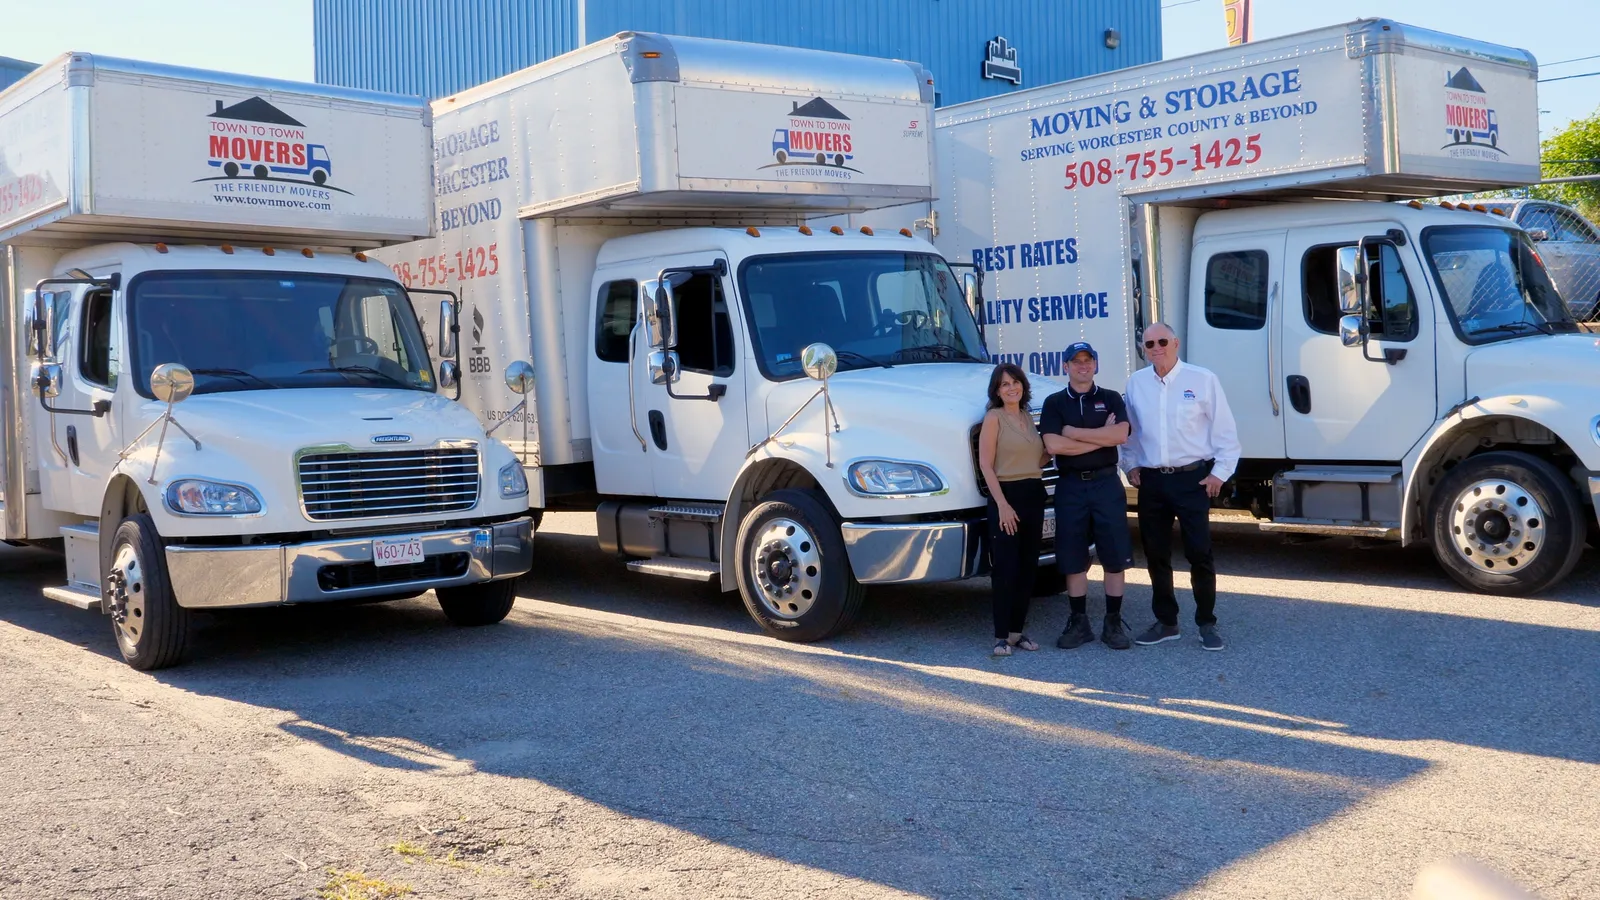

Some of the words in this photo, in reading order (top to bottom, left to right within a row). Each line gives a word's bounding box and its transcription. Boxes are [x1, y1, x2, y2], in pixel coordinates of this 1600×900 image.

[1030, 100, 1131, 139] MOVING
[1139, 96, 1157, 119] &
[1165, 68, 1302, 115] STORAGE
[790, 119, 814, 129] TOWN
[815, 120, 826, 130] TO
[827, 121, 851, 131] TOWN
[1446, 104, 1488, 130] MOVERS
[210, 121, 248, 134] TOWN
[251, 125, 266, 136] TO
[269, 128, 305, 140] TOWN
[789, 130, 853, 153] MOVERS
[1020, 141, 1075, 162] SERVING
[1078, 127, 1163, 151] WORCESTER
[1167, 114, 1231, 137] COUNTY
[1234, 111, 1247, 126] &
[1249, 100, 1318, 124] BEYOND
[209, 135, 306, 166] MOVERS
[1063, 133, 1262, 190] 508-755-1425
[775, 169, 788, 177] THE
[791, 168, 822, 177] FRIENDLY
[824, 169, 852, 180] MOVERS
[213, 194, 332, 210] www.townmove.com
[214, 183, 234, 192] THE
[238, 183, 287, 194] FRIENDLY
[289, 187, 331, 200] MOVERS
[441, 197, 502, 231] BEYOND
[972, 245, 1016, 273] BEST
[1020, 237, 1078, 268] RATES
[1028, 292, 1109, 323] SERVICE
[469, 357, 491, 373] BBB
[486, 410, 497, 420] US
